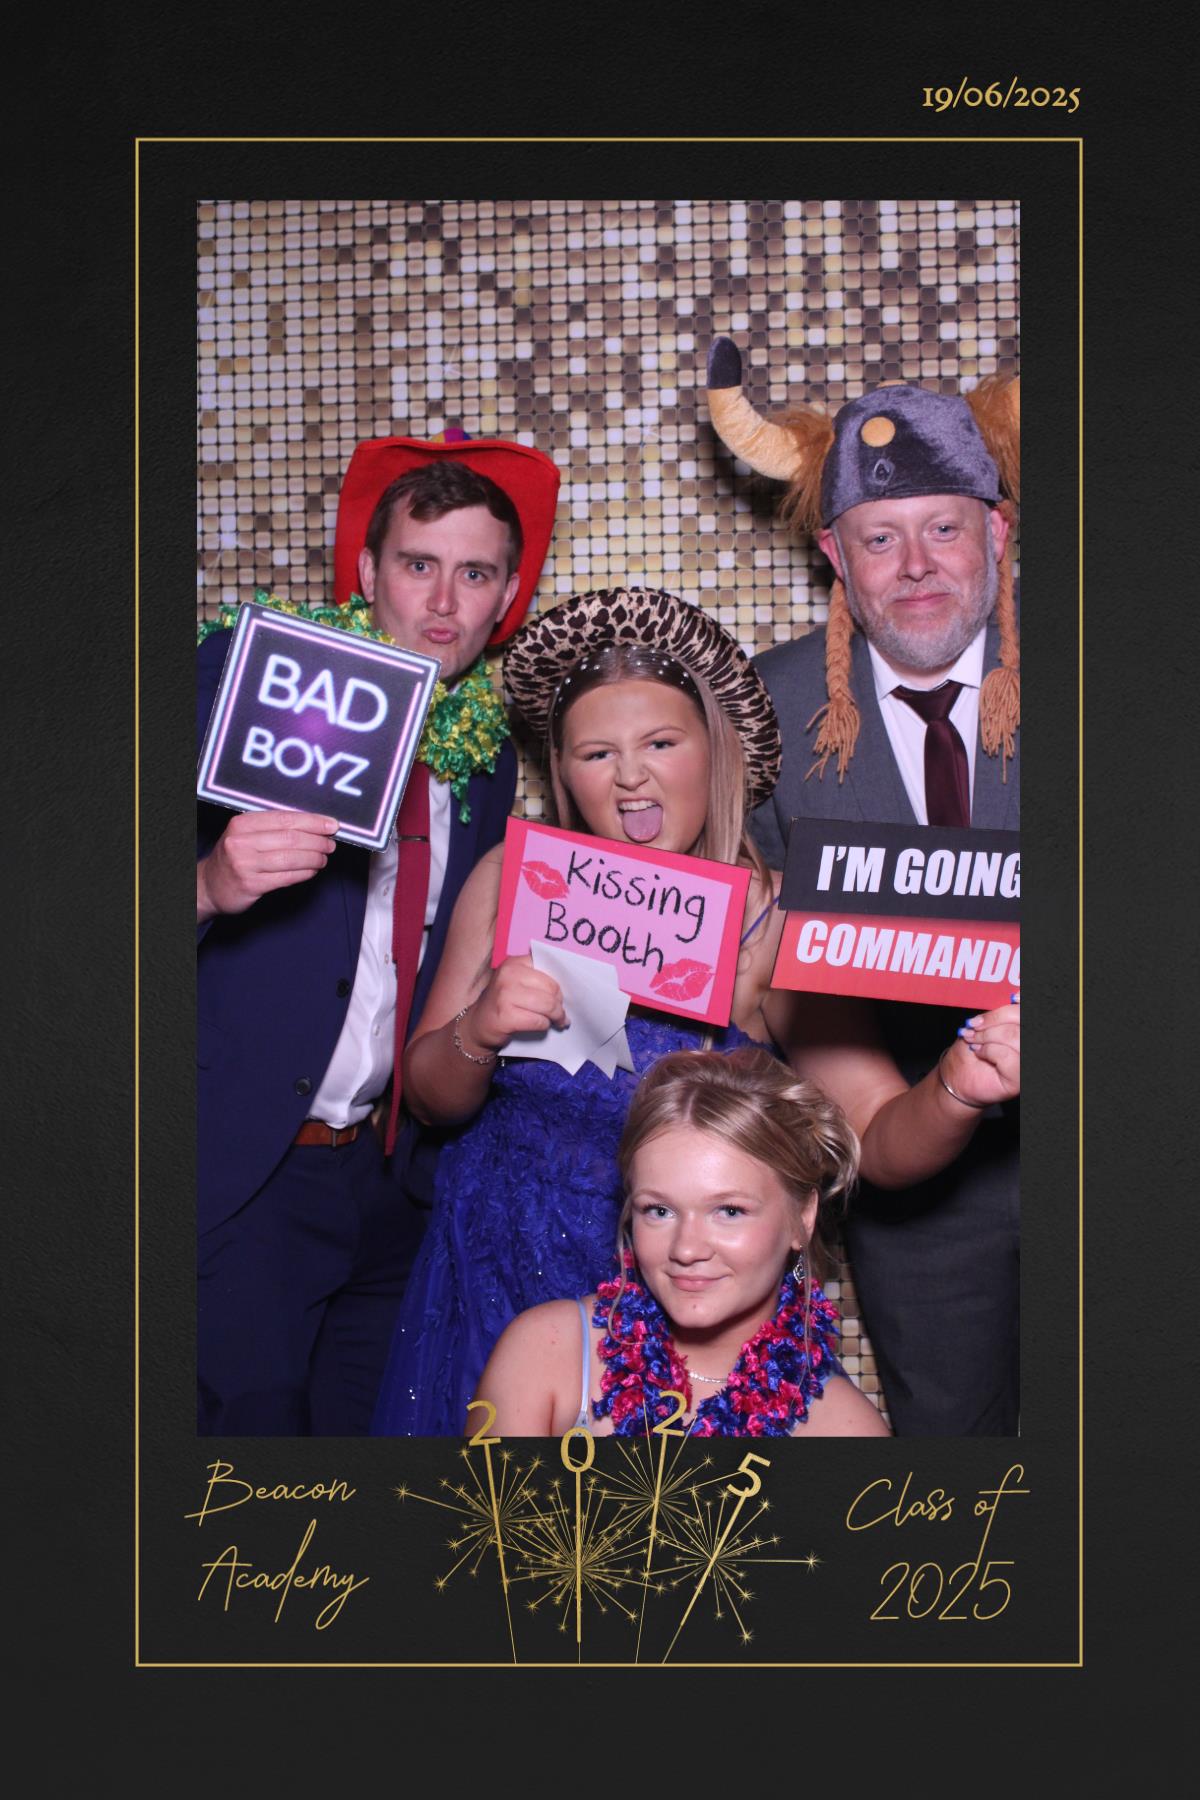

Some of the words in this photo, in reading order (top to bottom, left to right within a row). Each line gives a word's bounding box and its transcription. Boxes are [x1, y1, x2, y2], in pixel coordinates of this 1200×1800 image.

[258, 654, 388, 732] BAD
[242, 726, 370, 797] BOYZ
[567, 850, 706, 943] Kissing
[816, 845, 886, 893] I'M
[893, 848, 1020, 899] GOING
[544, 901, 664, 973] Booth
